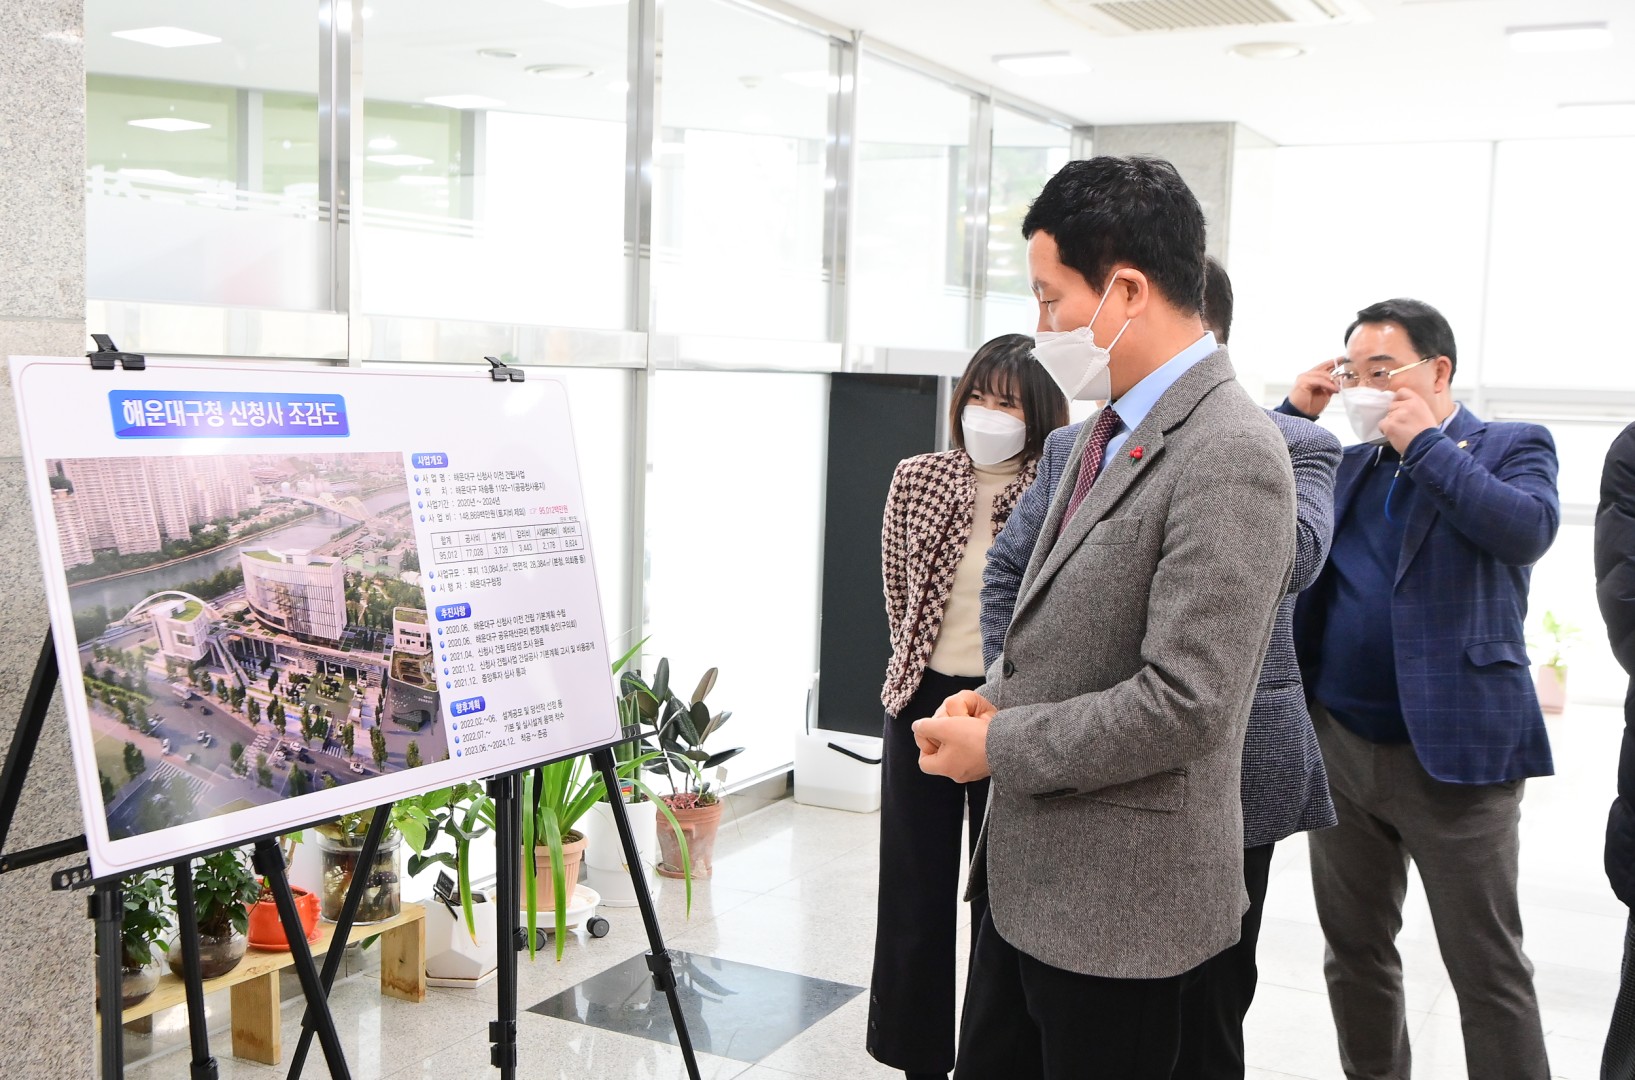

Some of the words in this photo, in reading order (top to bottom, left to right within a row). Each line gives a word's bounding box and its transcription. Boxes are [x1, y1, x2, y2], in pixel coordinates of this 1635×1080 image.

[122, 398, 224, 428] 해운대구청
[229, 401, 283, 427] 신청사
[288, 401, 340, 426] 조감도
[418, 455, 443, 466] 사업개요
[453, 472, 475, 481] 해운대구
[476, 471, 492, 481] 신청사
[493, 471, 504, 480] 이전
[505, 470, 525, 480] 건립사업
[456, 486, 477, 495] 해운대구
[478, 484, 494, 493] 재송동
[427, 500, 449, 510] 사업기간
[440, 536, 451, 545] 합계
[465, 534, 480, 543] 공사비
[491, 532, 506, 541] 설계비
[516, 529, 531, 539] 감리비
[439, 550, 458, 560] 95,012
[466, 548, 484, 557] 77,028
[494, 546, 508, 555] 3,739
[519, 544, 532, 552] 3,443
[542, 541, 556, 550] 2,178
[438, 569, 460, 579] 사업규모
[468, 566, 479, 575] 부지
[512, 561, 528, 571] 연면적
[470, 577, 502, 588] 해운대구청장
[441, 605, 466, 618] 추진사항
[446, 624, 470, 634] 2020.06.
[474, 619, 495, 630] 해운대구
[496, 617, 512, 628] 신청사
[513, 615, 524, 624] 이전
[524, 613, 535, 623] 건립
[536, 610, 555, 621] 기본계획
[556, 609, 566, 618] 수립
[448, 637, 472, 648] 2020.06.
[476, 632, 497, 643] 해운대구
[498, 627, 528, 640] 공유재산관리
[530, 624, 550, 635] 변경계획
[550, 619, 577, 632] 승인(구의회)
[450, 650, 474, 662] 2021.04.
[478, 646, 494, 657] 신청사
[495, 644, 506, 654] 건립
[506, 641, 522, 652] 타당성
[523, 639, 533, 649] 조사
[534, 638, 544, 648] 완료
[452, 663, 476, 675] 2021.12.
[480, 659, 496, 670] 신청사
[497, 655, 518, 666] 건립사업
[518, 651, 539, 663] 건설공사
[540, 648, 559, 659] 기본계획
[560, 646, 570, 655] 고시
[454, 676, 478, 688] 2021.12.
[482, 671, 503, 684] 중앙투자
[504, 669, 514, 679] 심사
[516, 667, 526, 677] 통과
[455, 699, 481, 714] 향후계획
[502, 708, 523, 720] 설계공모
[530, 704, 546, 715] 당선작
[546, 701, 556, 713] 선정
[504, 723, 515, 732] 기본
[522, 716, 542, 730] 실시설계
[543, 714, 554, 725] 용역
[554, 712, 565, 721] 착수
